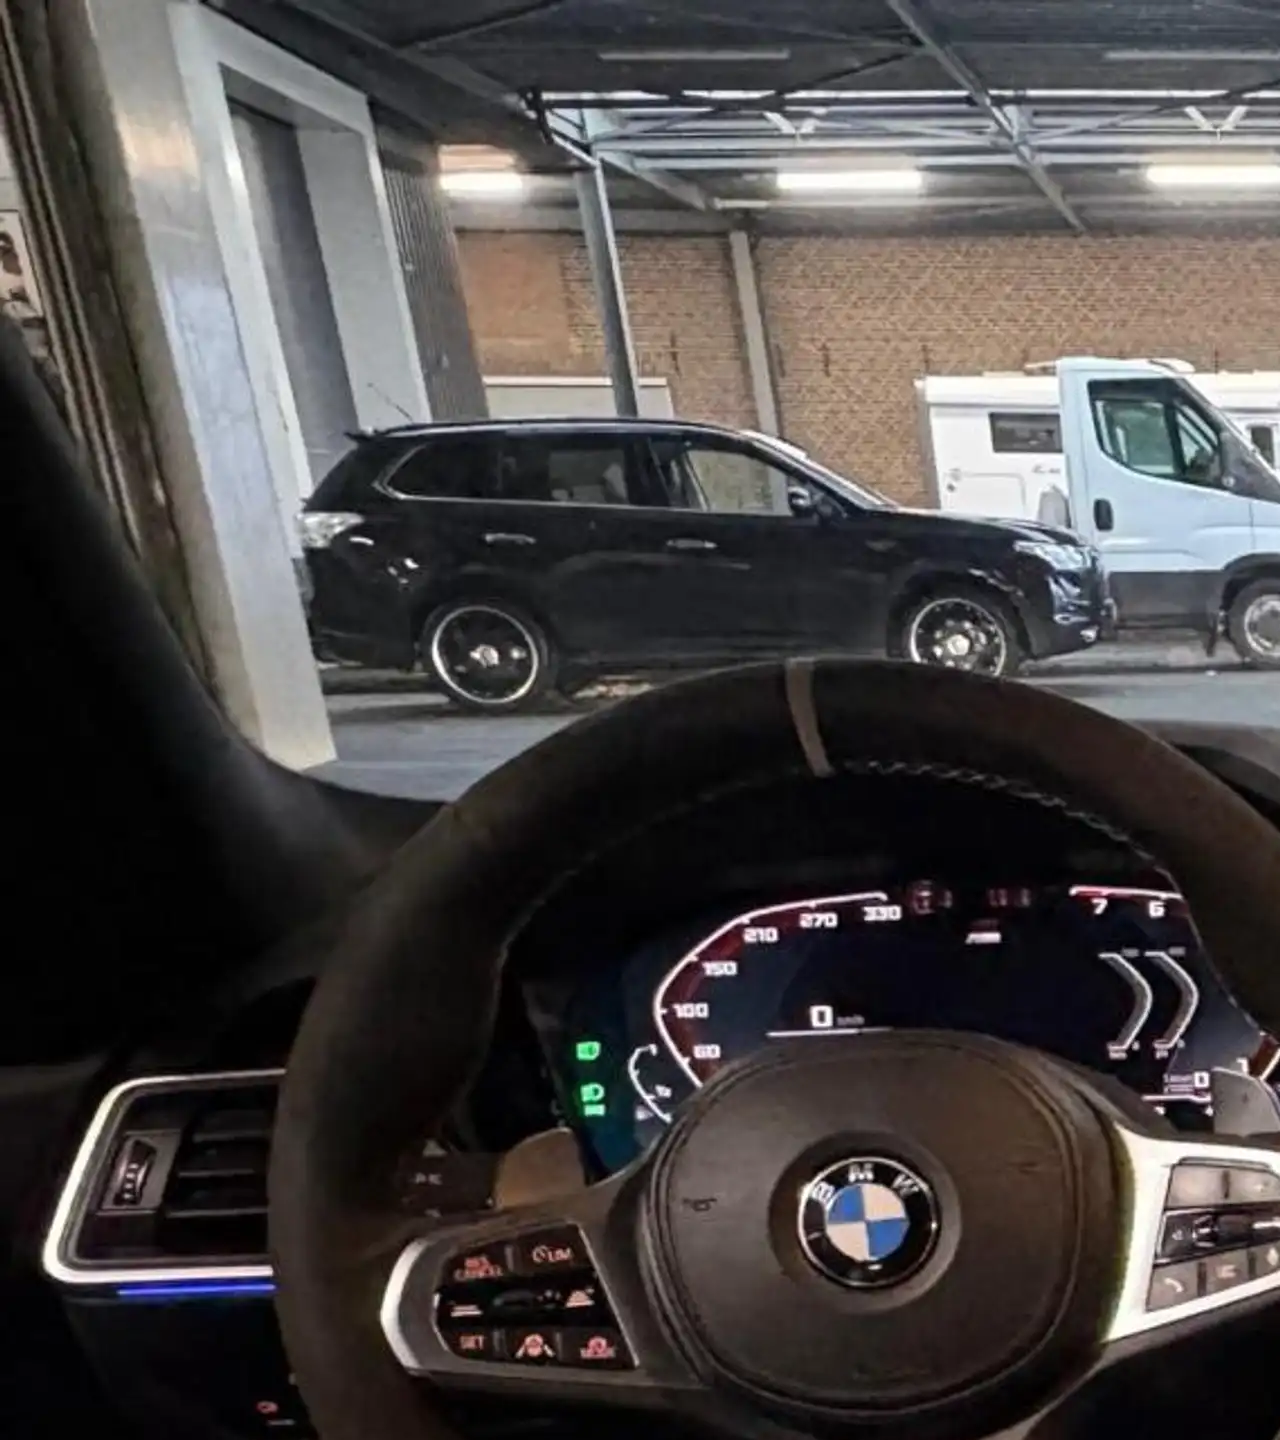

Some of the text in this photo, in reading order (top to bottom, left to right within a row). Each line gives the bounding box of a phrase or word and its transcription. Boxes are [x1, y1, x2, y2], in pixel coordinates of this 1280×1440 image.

[863, 906, 901, 921] 330
[1091, 898, 1108, 914] 7
[1149, 901, 1166, 917] 6
[799, 913, 838, 928] 270
[743, 928, 778, 943] 210
[702, 961, 737, 976] 150
[672, 1003, 709, 1018] 100
[810, 1005, 833, 1027] 0
[811, 1163, 921, 1203] BMW
